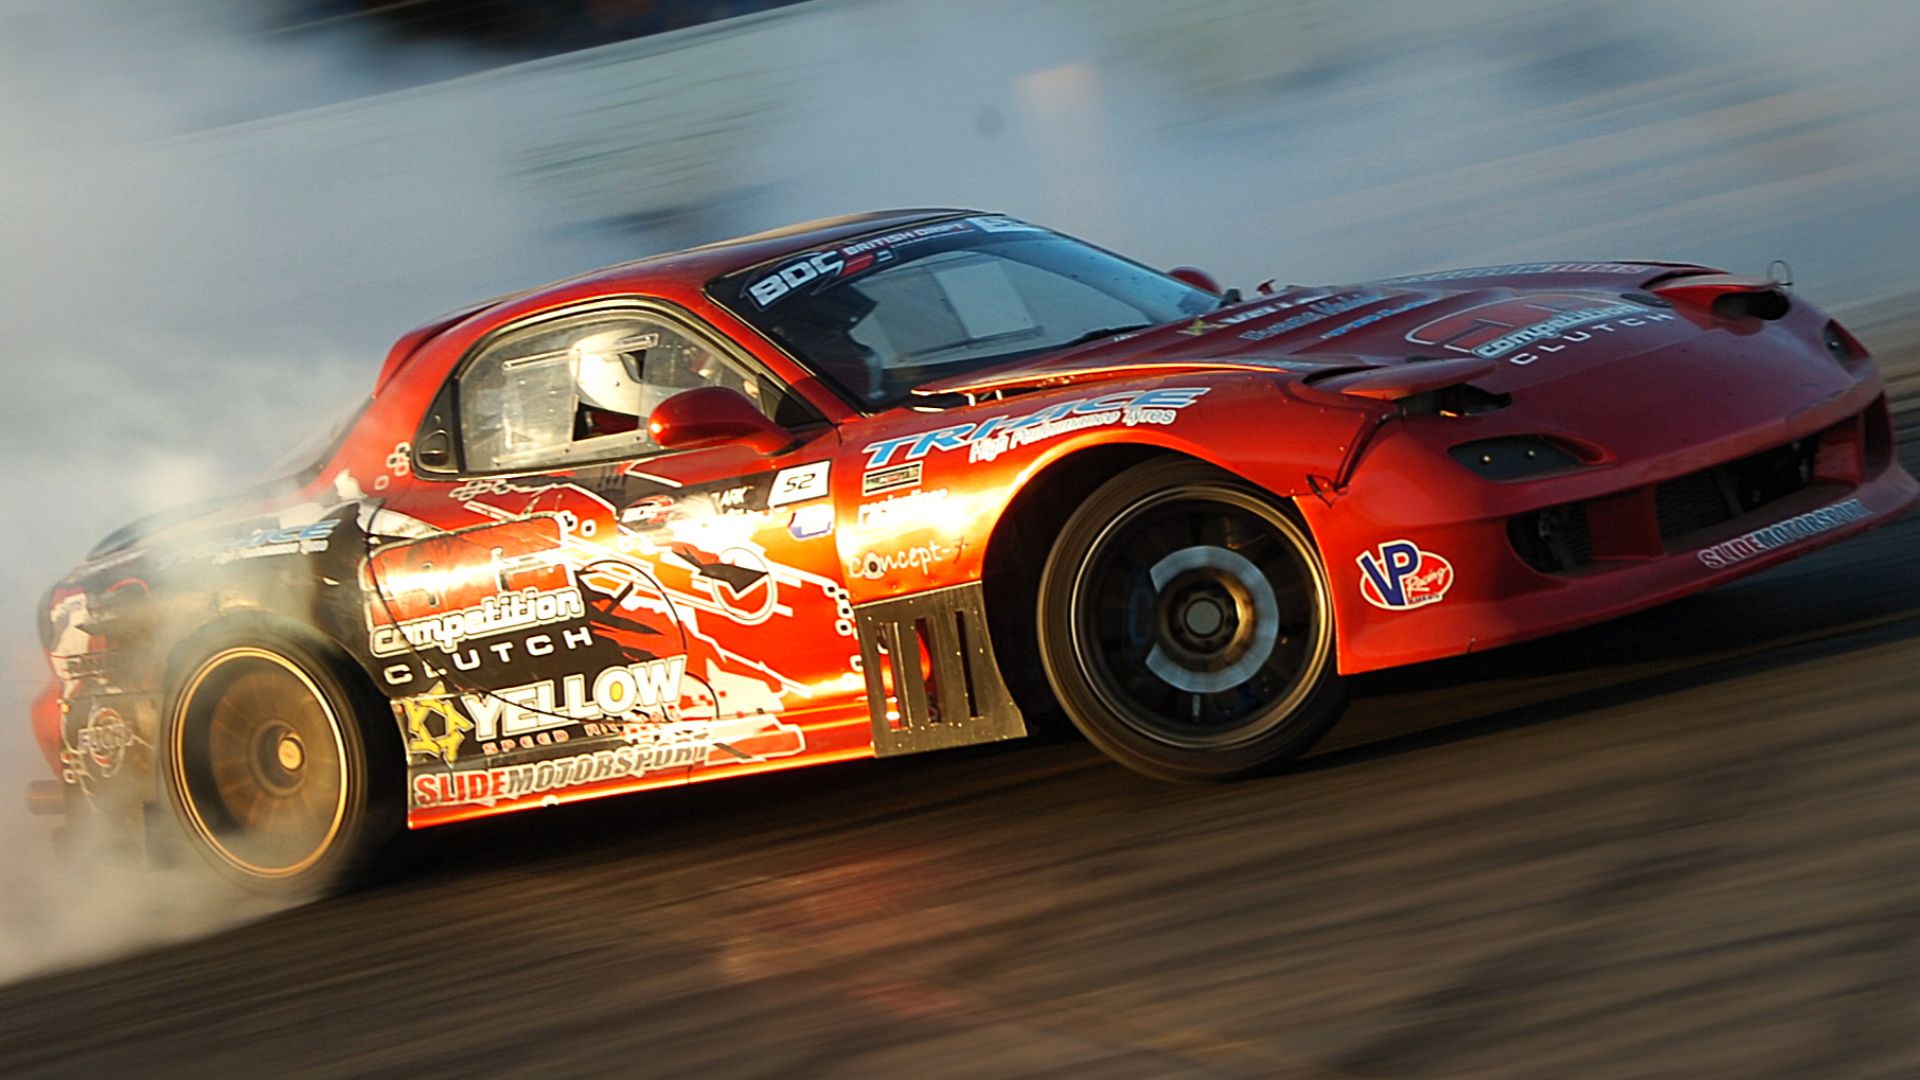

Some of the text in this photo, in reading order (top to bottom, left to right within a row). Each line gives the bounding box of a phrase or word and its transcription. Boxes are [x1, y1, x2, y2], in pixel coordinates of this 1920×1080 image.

[843, 229, 914, 256] BRITISH
[1472, 303, 1648, 358] competition
[1510, 312, 1675, 365] CLUTCH
[968, 431, 1009, 464] High
[1122, 405, 1177, 427] Tyres
[1358, 541, 1420, 607] VP
[383, 626, 594, 685] CLUTCH
[461, 654, 688, 741] YELLOW
[482, 729, 570, 756] SPEED
